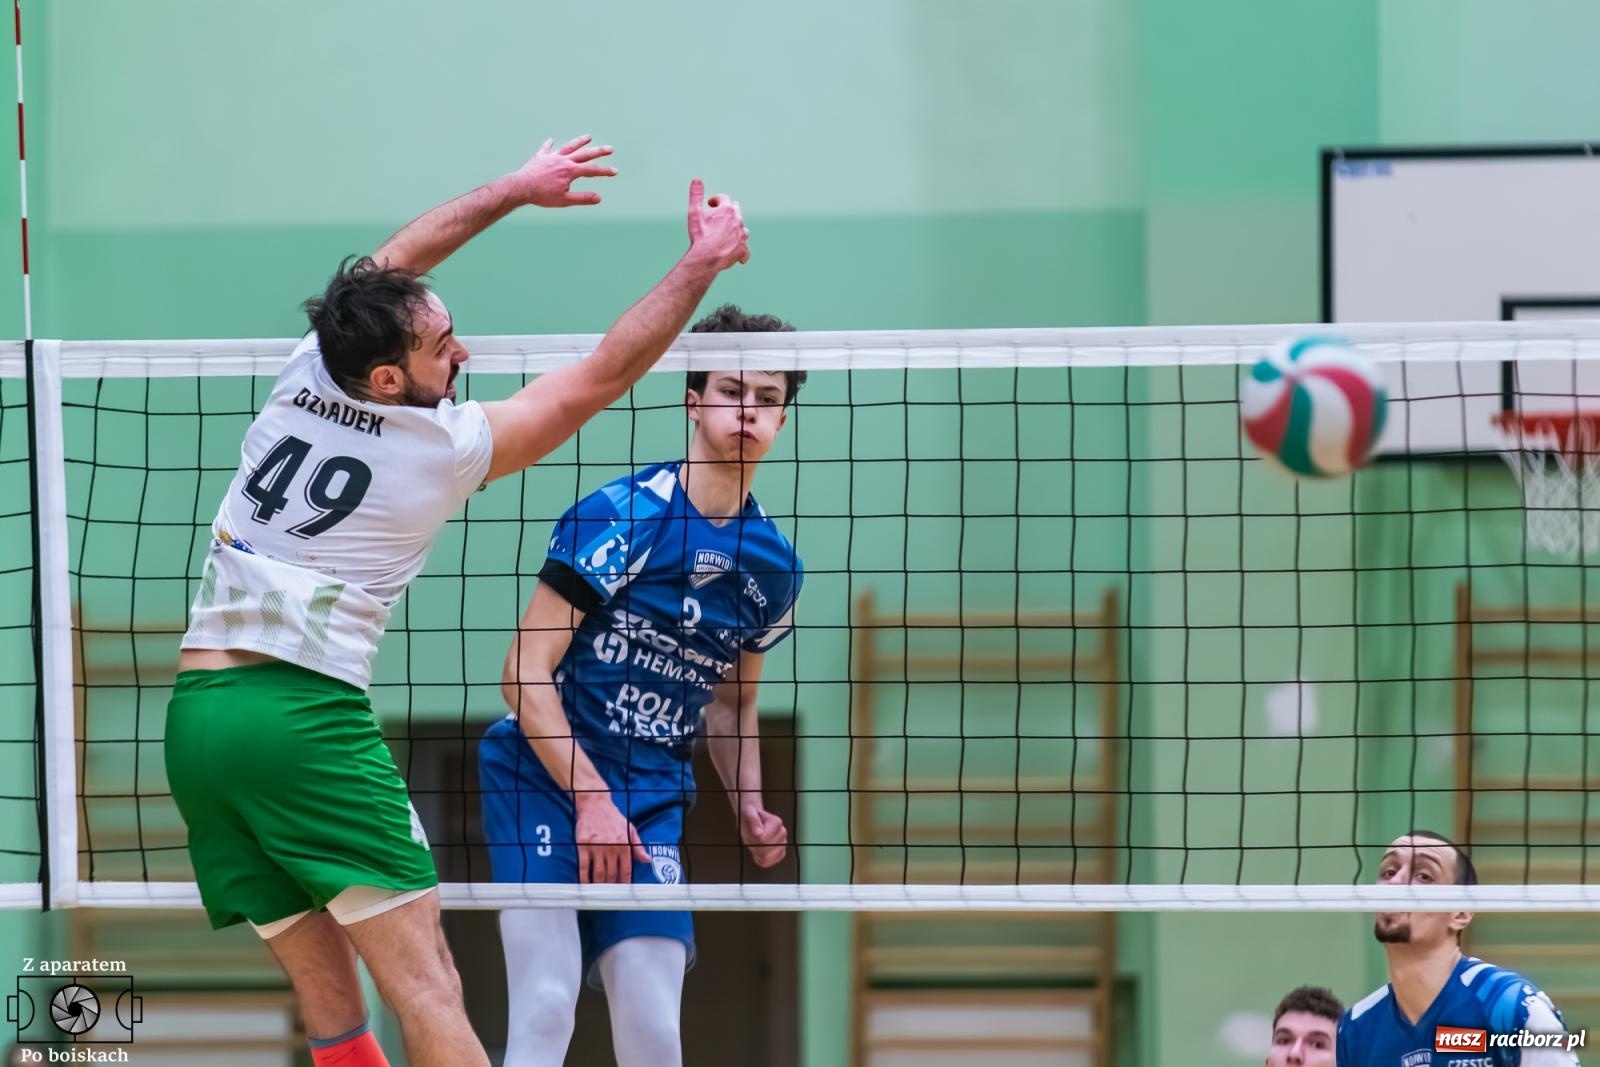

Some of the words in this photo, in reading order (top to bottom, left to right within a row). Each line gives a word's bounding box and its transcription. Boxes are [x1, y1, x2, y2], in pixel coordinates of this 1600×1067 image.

[293, 387, 385, 437] DZIADEK
[241, 434, 373, 540] 49
[697, 552, 730, 570] NORWID
[535, 824, 552, 857] 3
